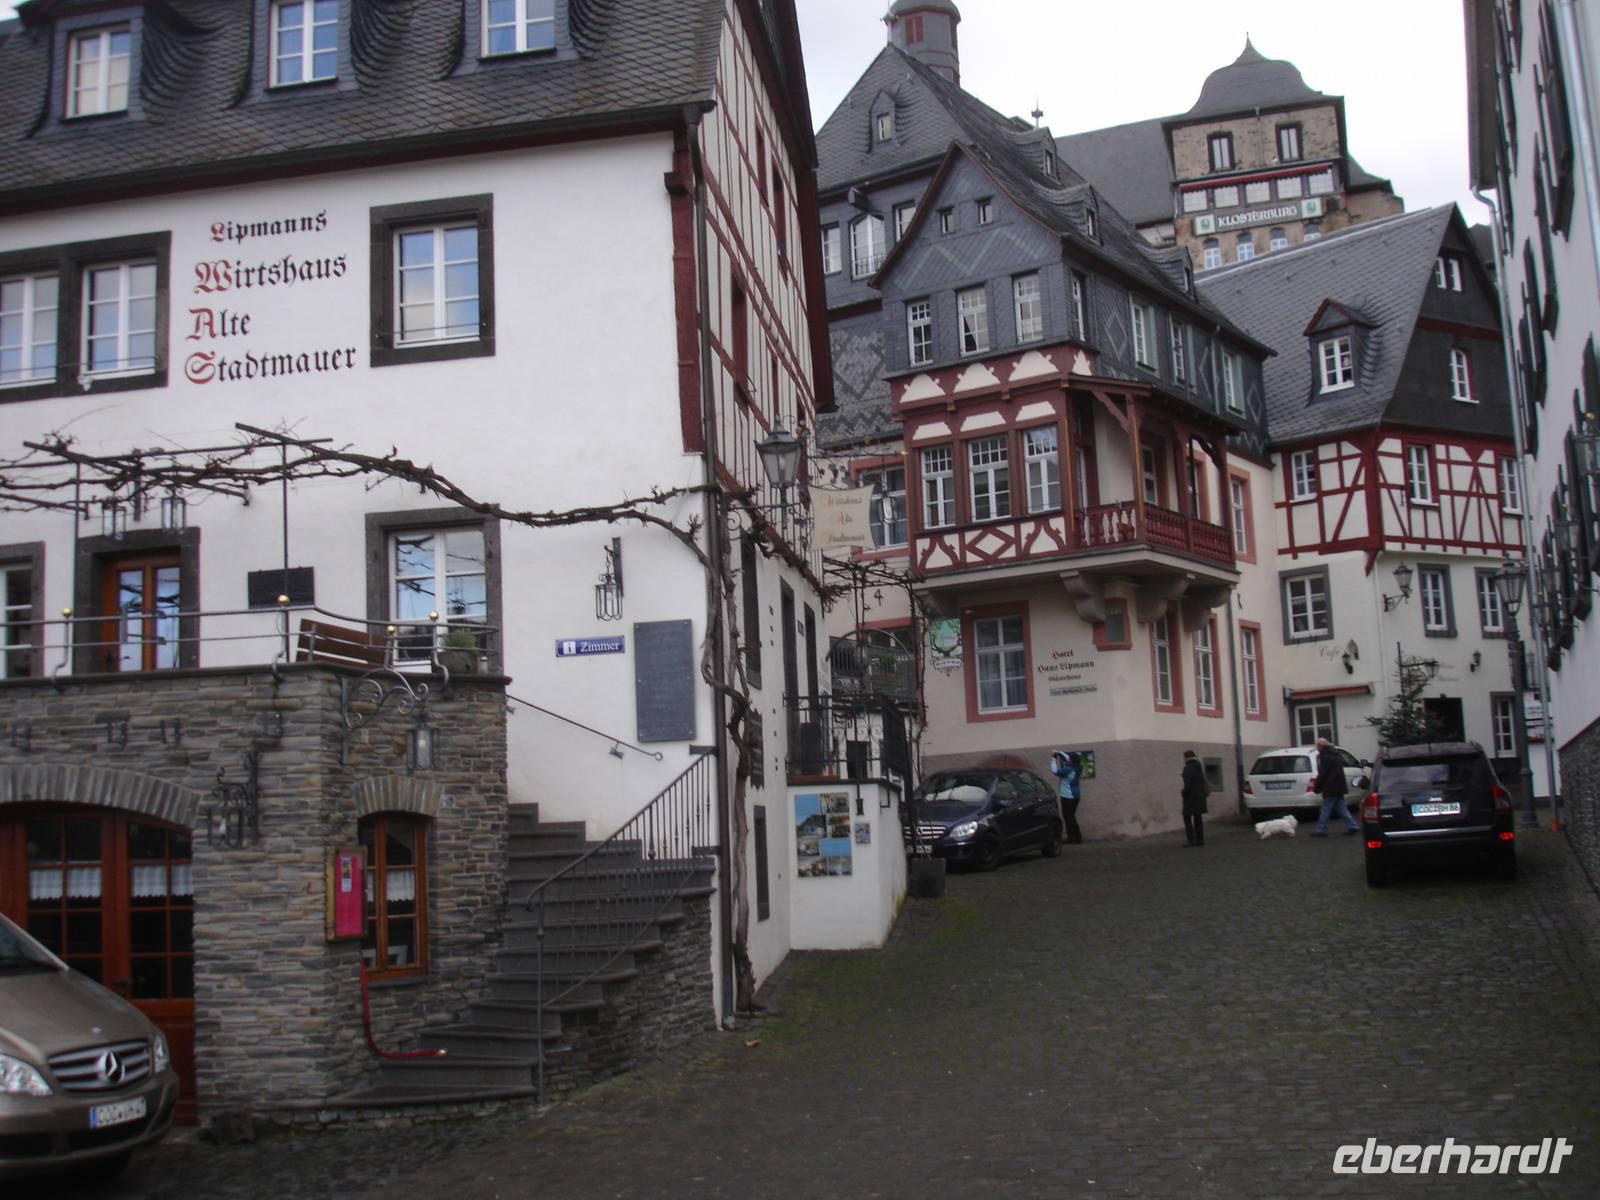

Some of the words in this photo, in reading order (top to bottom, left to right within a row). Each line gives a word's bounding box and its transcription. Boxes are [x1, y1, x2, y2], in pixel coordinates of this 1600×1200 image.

[210, 209, 327, 245] Lipmanns
[1218, 206, 1298, 226] KLOSTERBURG
[193, 253, 347, 295] Wirtshaus
[185, 307, 251, 341] Alte
[184, 346, 357, 385] Stadtmauer
[580, 642, 620, 653] Zimmer
